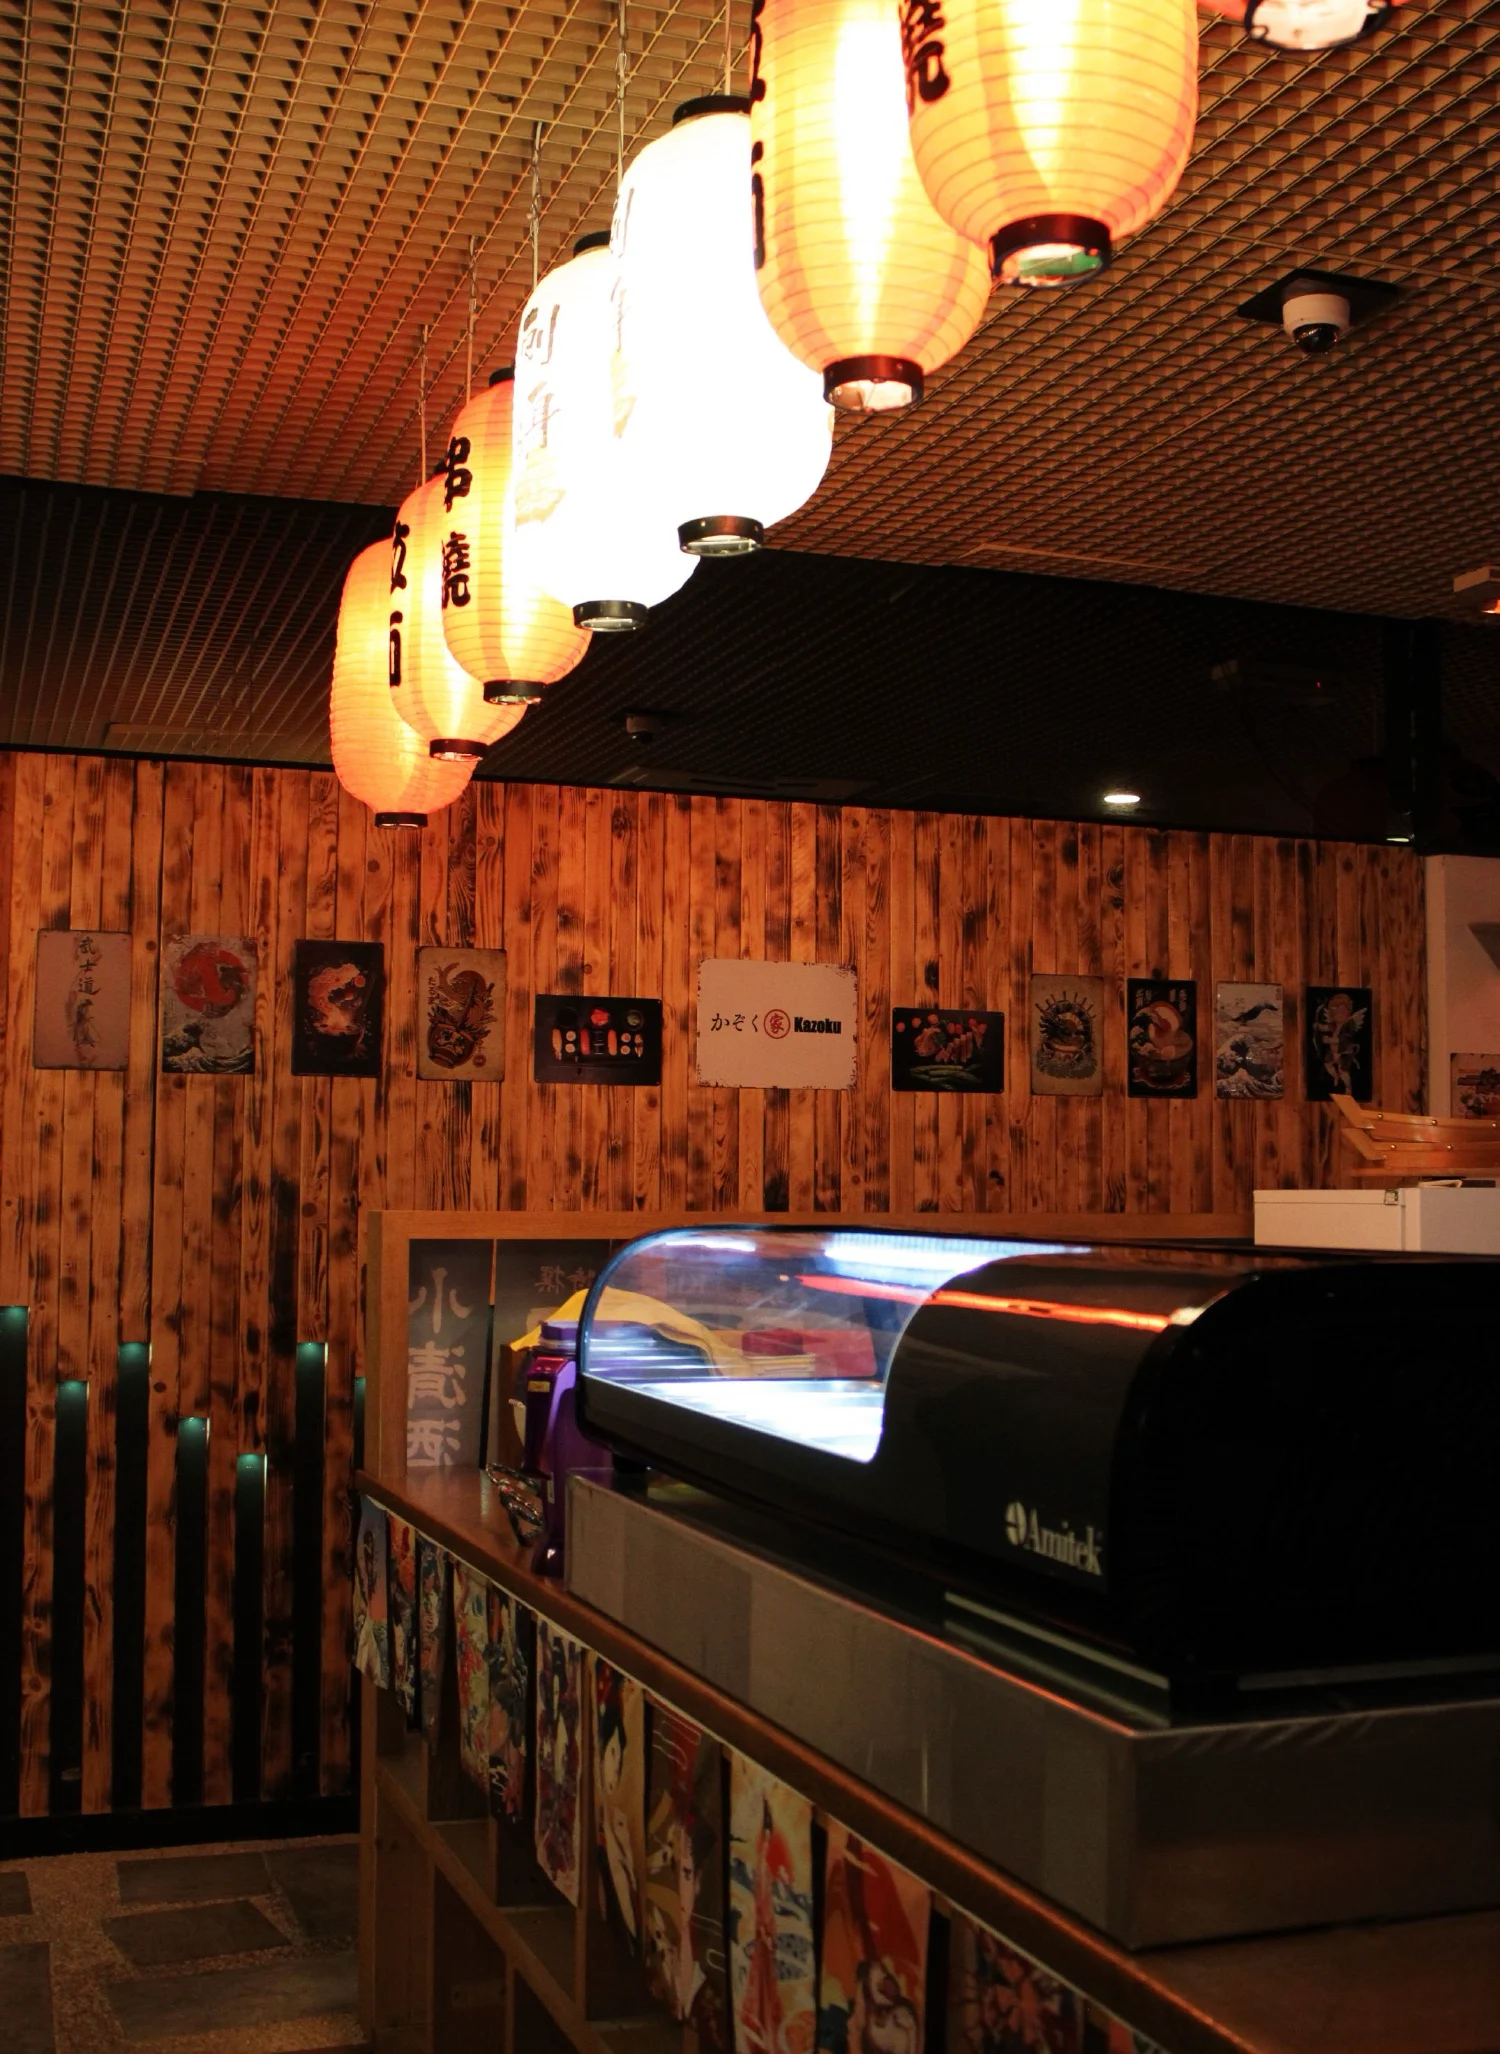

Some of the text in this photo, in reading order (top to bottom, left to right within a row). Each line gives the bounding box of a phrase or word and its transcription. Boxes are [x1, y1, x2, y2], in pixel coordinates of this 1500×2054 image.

[79, 936, 101, 995] 武士道
[710, 1012, 842, 1034] かぞく 家 Kazoku
[1028, 1507, 1103, 1577] Amitek
